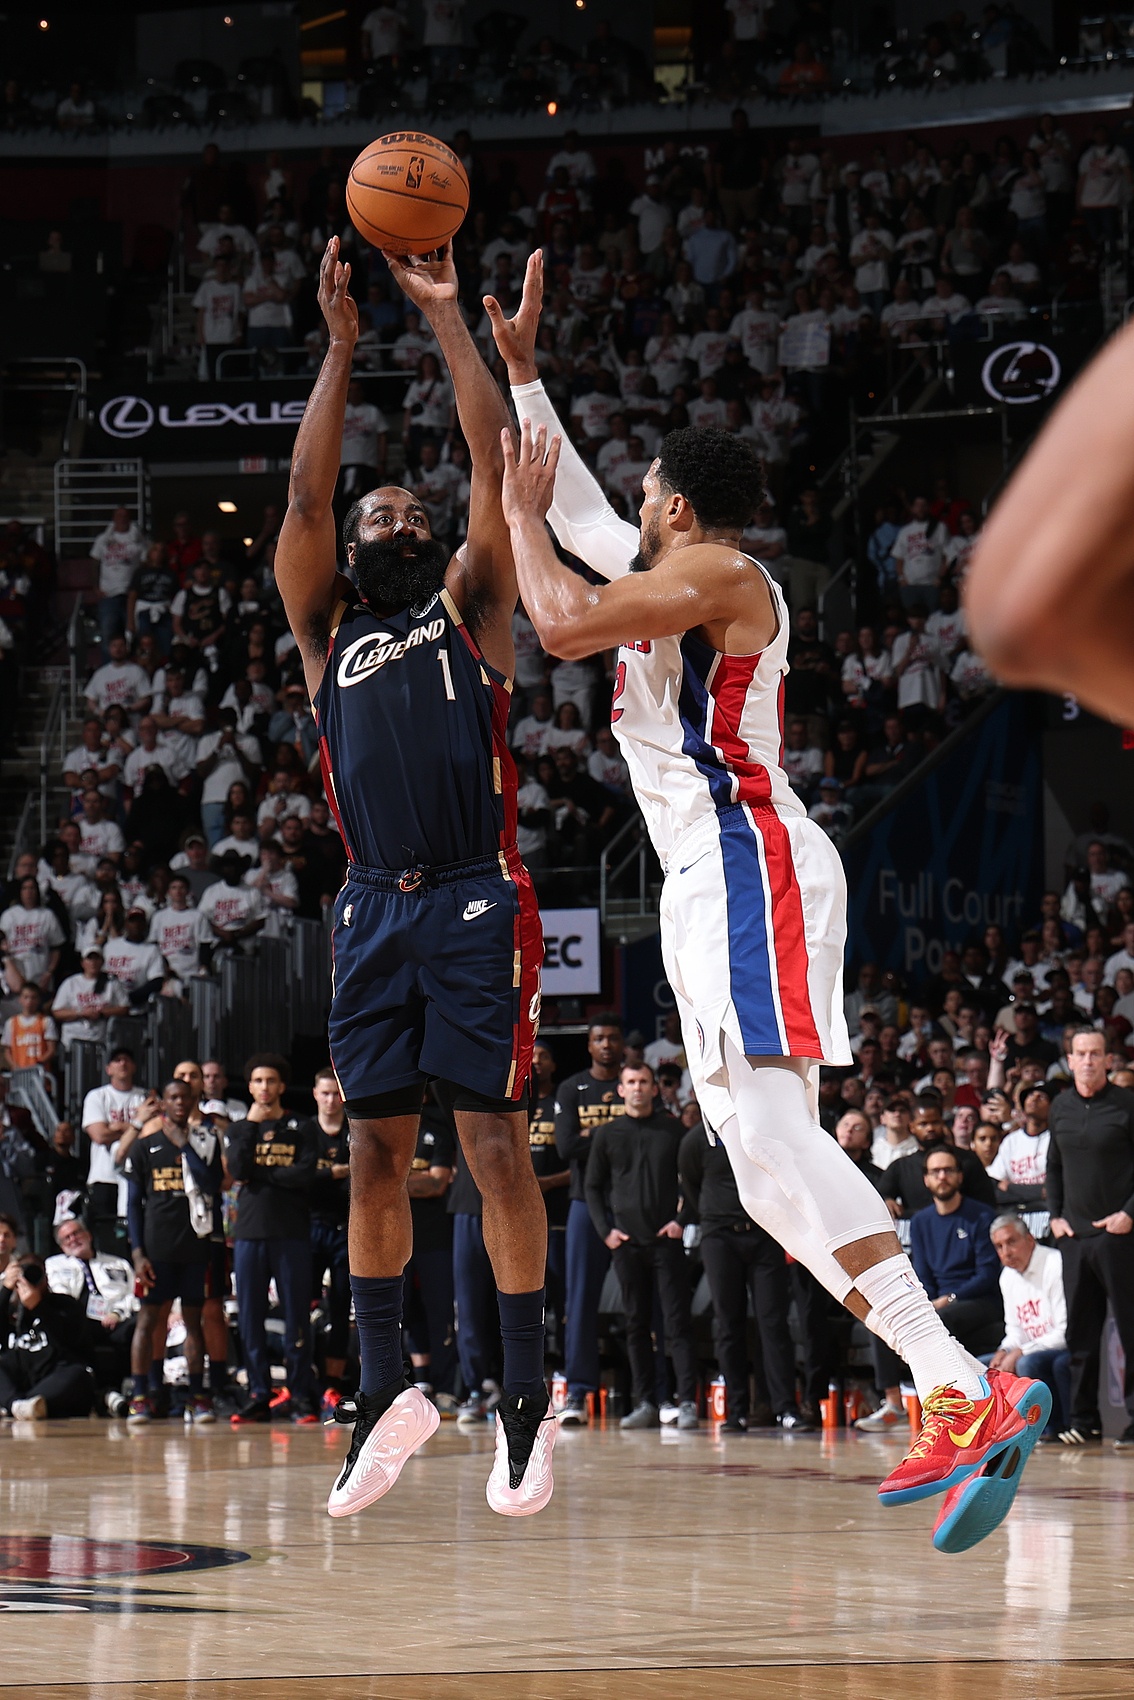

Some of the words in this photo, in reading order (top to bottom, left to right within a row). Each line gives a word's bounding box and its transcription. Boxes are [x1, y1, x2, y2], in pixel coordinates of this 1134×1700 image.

[158, 401, 307, 427] LEXUS
[336, 617, 446, 688] CLEVELAND
[436, 648, 457, 701] 1
[466, 899, 489, 913] NIKE
[879, 869, 934, 920] Full
[943, 877, 1024, 928] Court
[905, 926, 962, 974] Po
